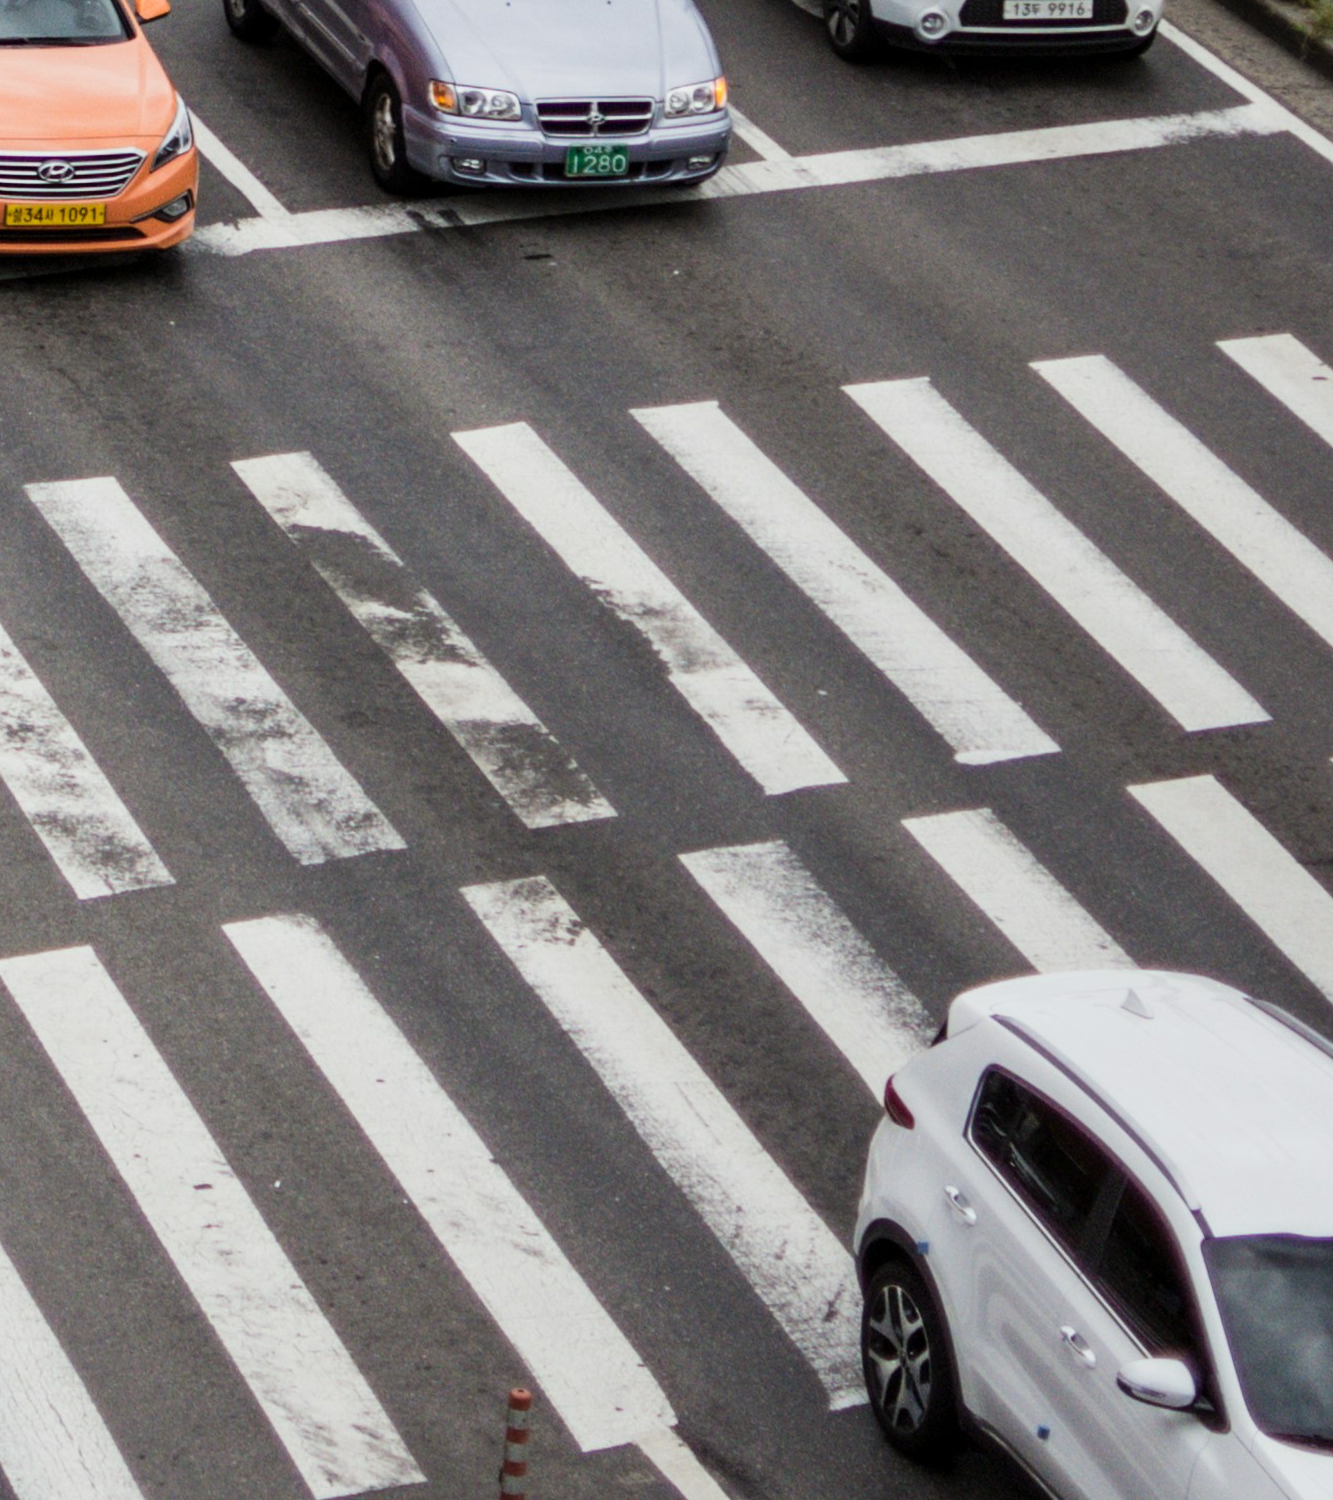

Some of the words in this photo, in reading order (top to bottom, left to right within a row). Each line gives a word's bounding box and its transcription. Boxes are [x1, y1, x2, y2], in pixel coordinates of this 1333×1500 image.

[1048, 3, 1085, 15] 9916
[573, 155, 622, 173] 1280
[58, 207, 96, 221] 1091
